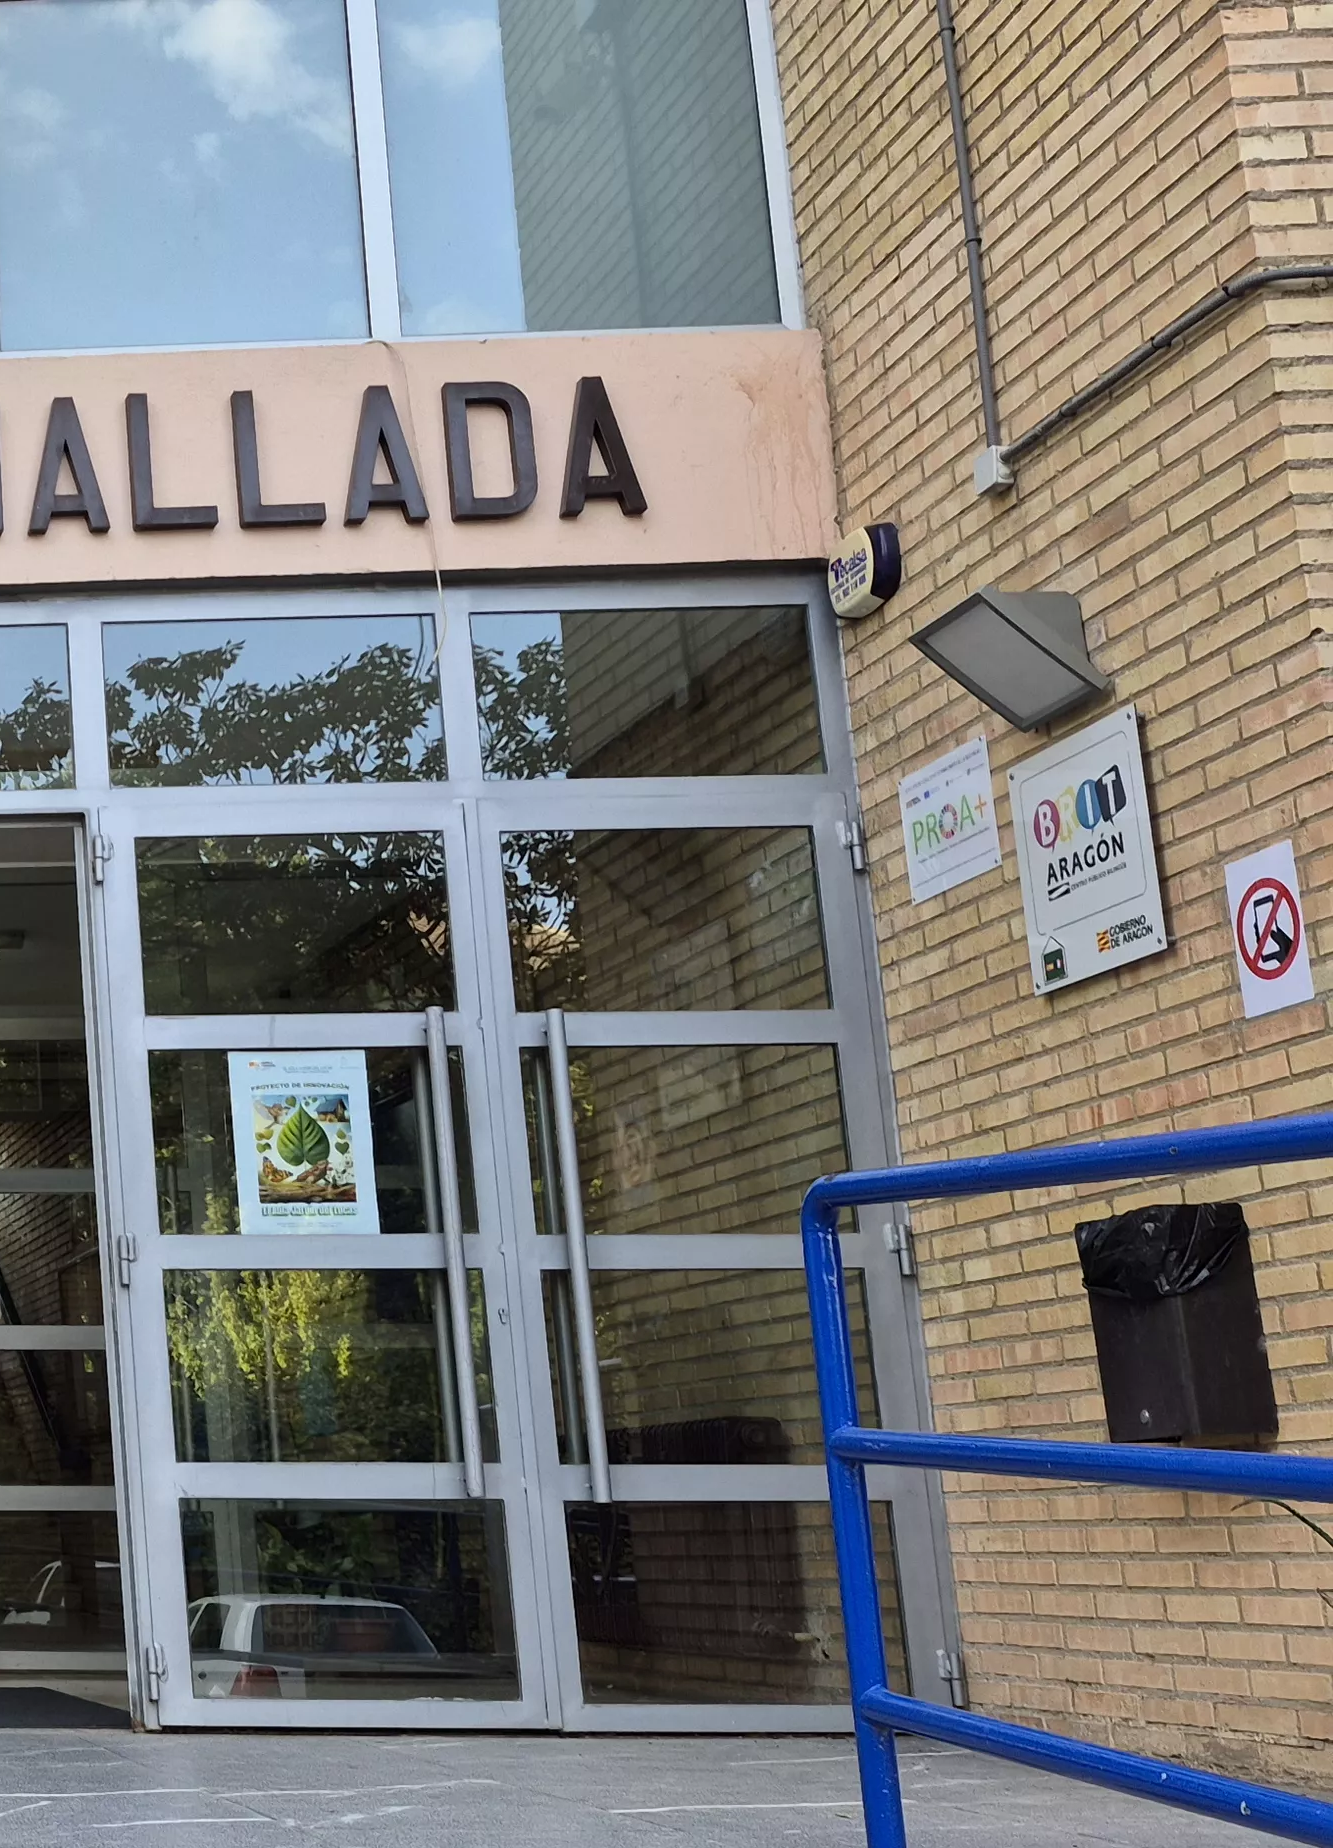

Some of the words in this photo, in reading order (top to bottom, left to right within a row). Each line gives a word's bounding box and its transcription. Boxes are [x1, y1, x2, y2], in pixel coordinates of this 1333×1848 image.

[911, 793, 987, 856] PROA+
[1036, 768, 1121, 849] BRIT
[1046, 831, 1125, 887] ARAGÓN
[1109, 914, 1146, 937] GOBIERNO
[1110, 936, 1121, 950] DE
